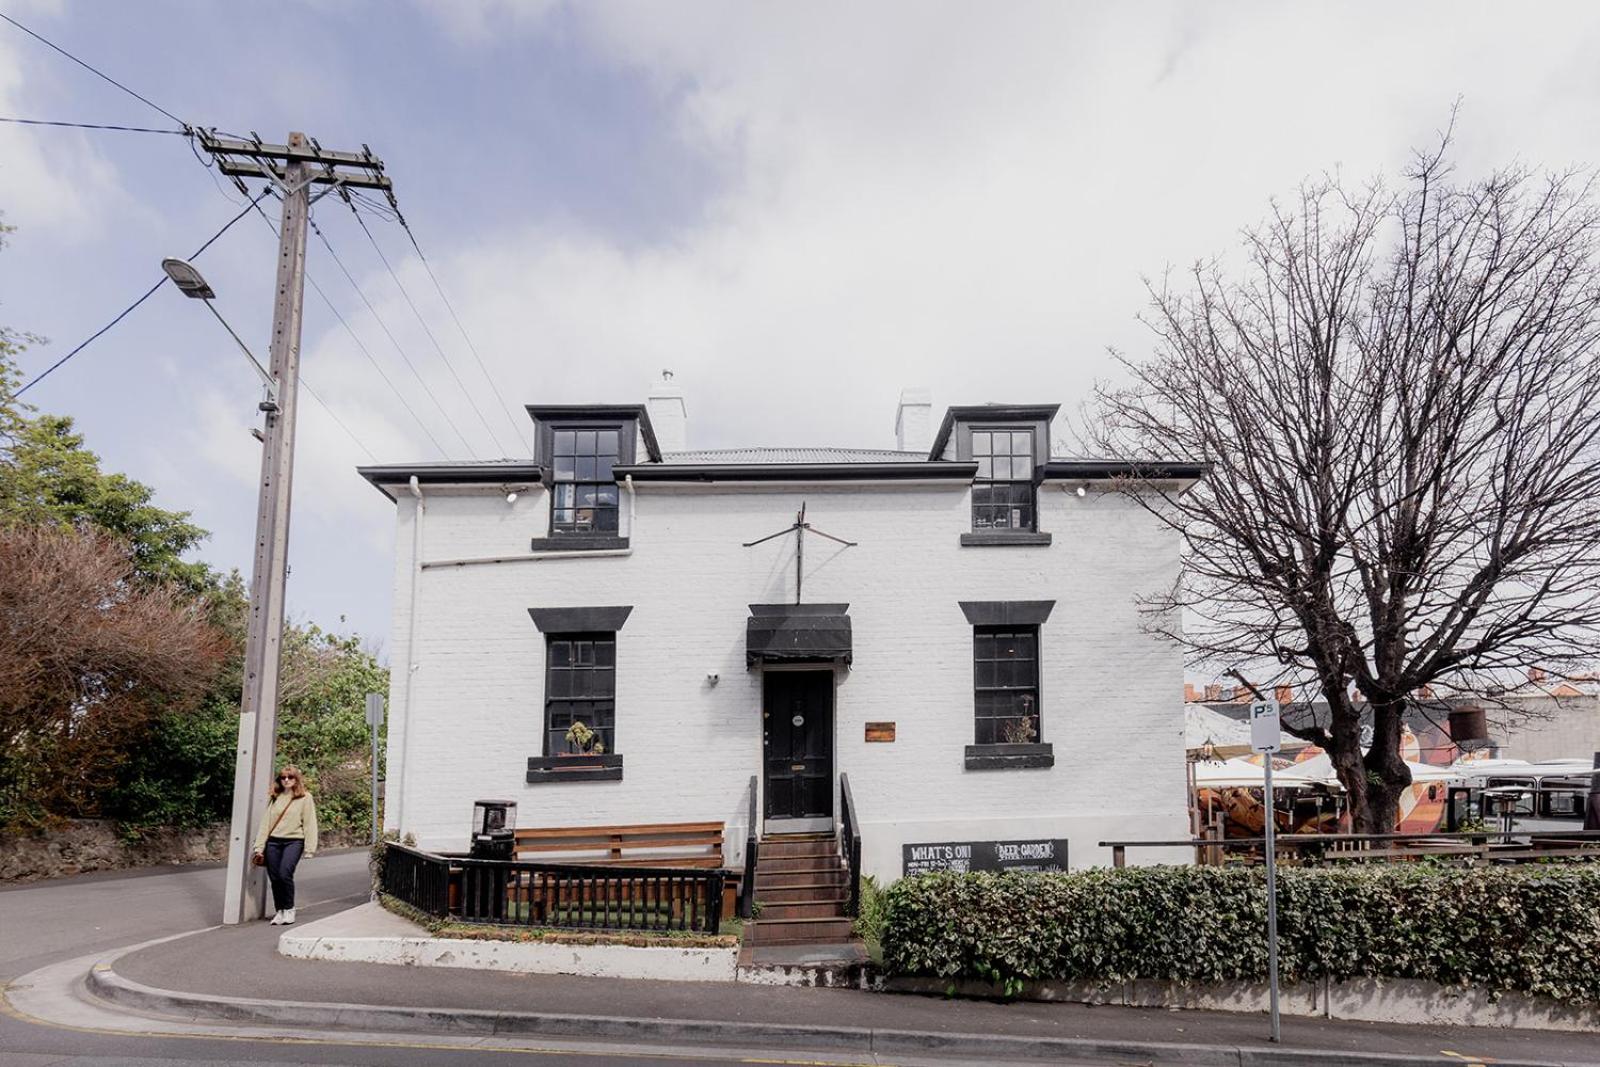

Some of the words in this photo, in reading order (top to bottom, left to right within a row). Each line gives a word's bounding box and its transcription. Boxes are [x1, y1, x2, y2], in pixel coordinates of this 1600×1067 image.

[911, 846, 954, 860] WHAT'S
[955, 845, 972, 858] ON!
[998, 844, 1019, 860] BEER
[1020, 843, 1052, 858] GARDEN
